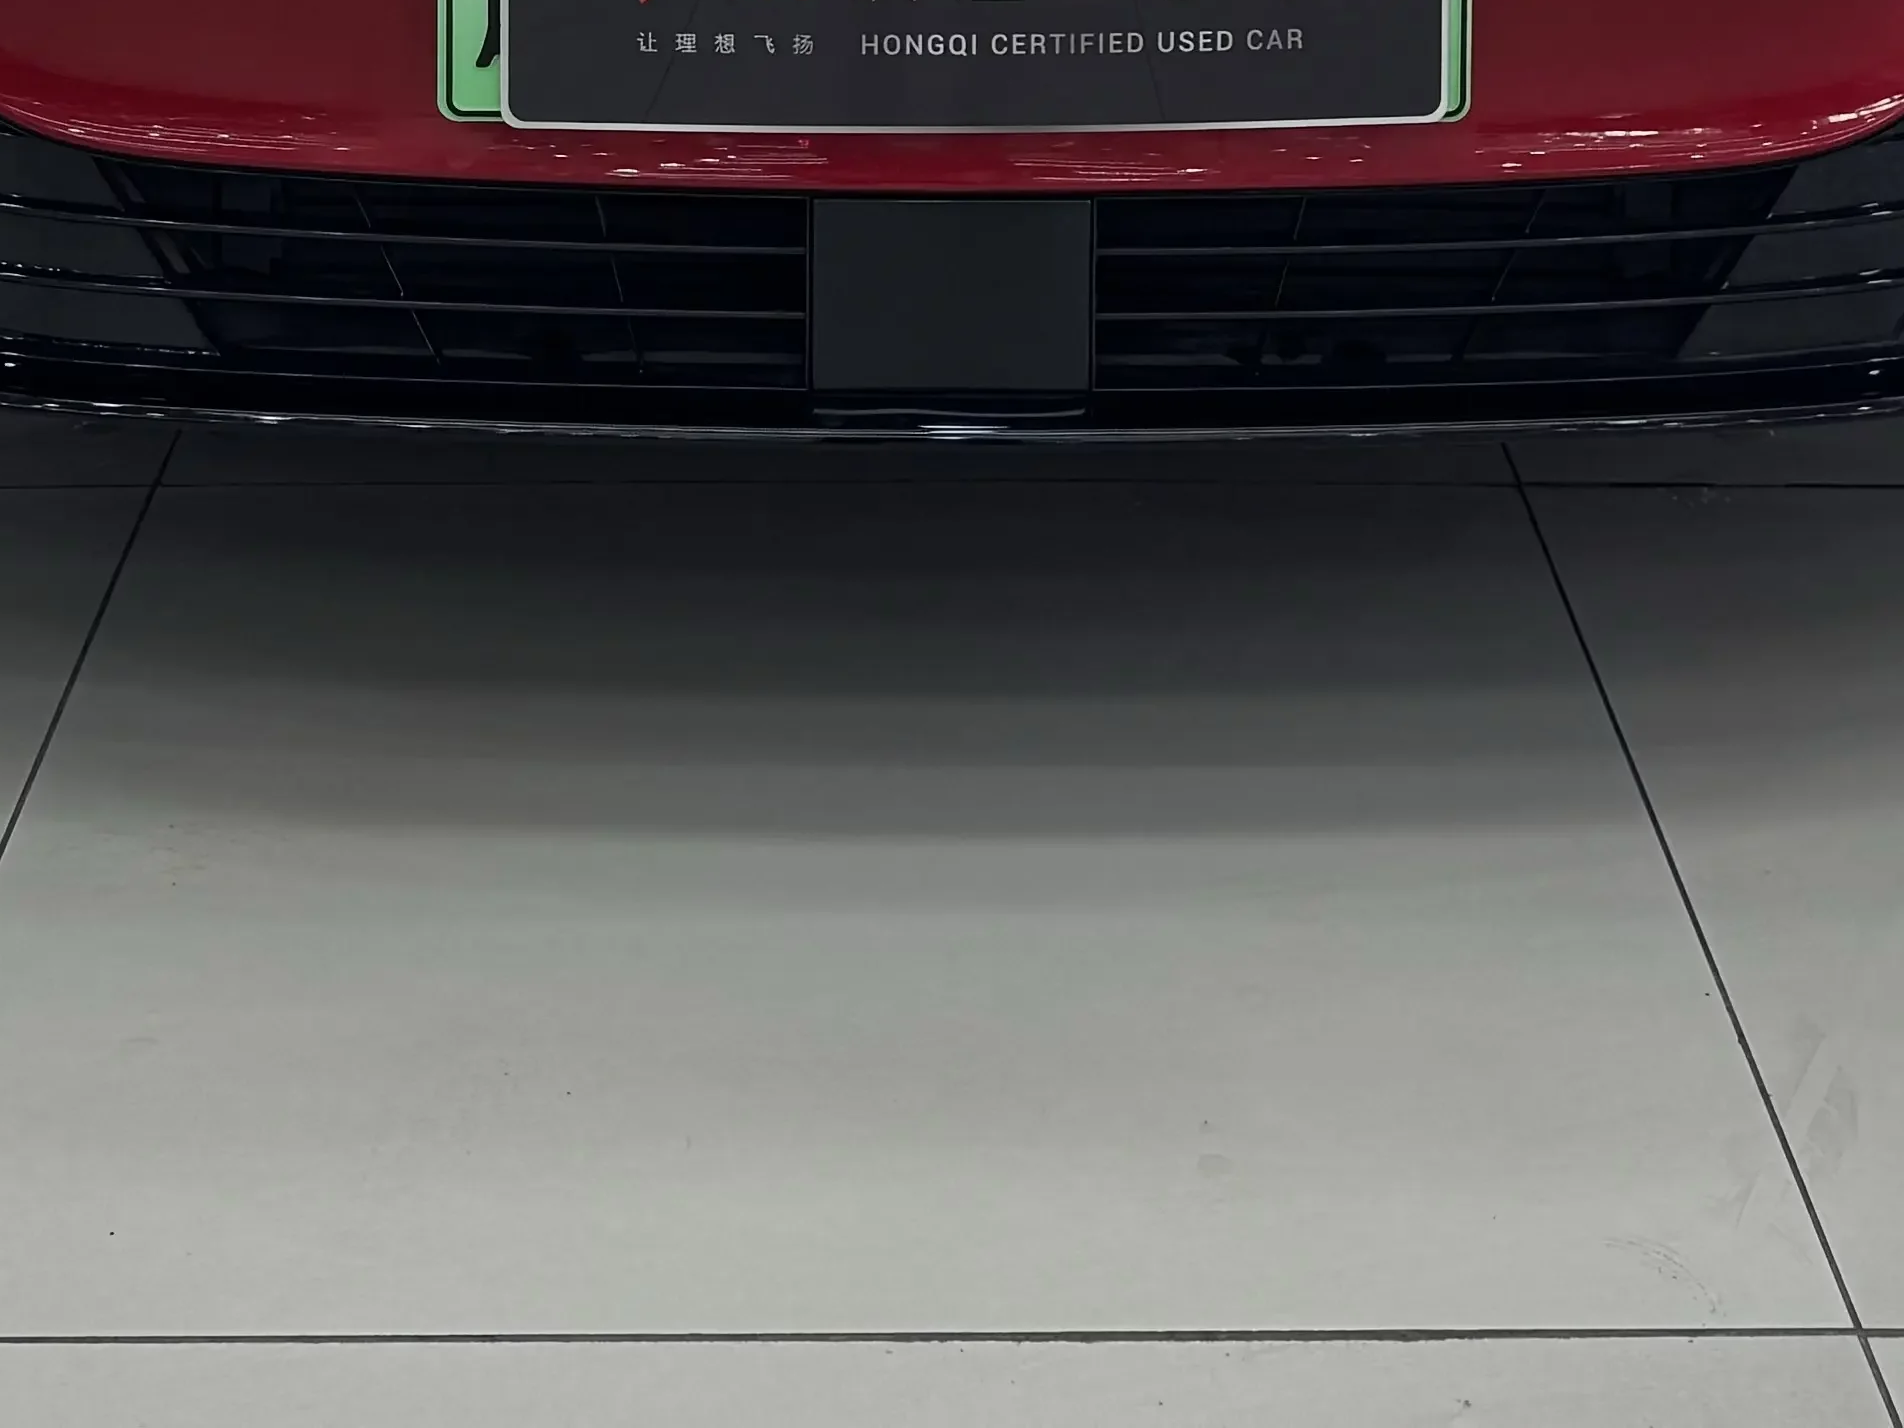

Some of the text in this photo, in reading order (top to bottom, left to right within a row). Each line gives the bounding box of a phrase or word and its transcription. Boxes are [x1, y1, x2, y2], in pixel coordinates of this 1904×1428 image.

[636, 31, 815, 56] 让理想飞扬
[861, 29, 1304, 58] HONGQI CERTIFIED USED CAR
